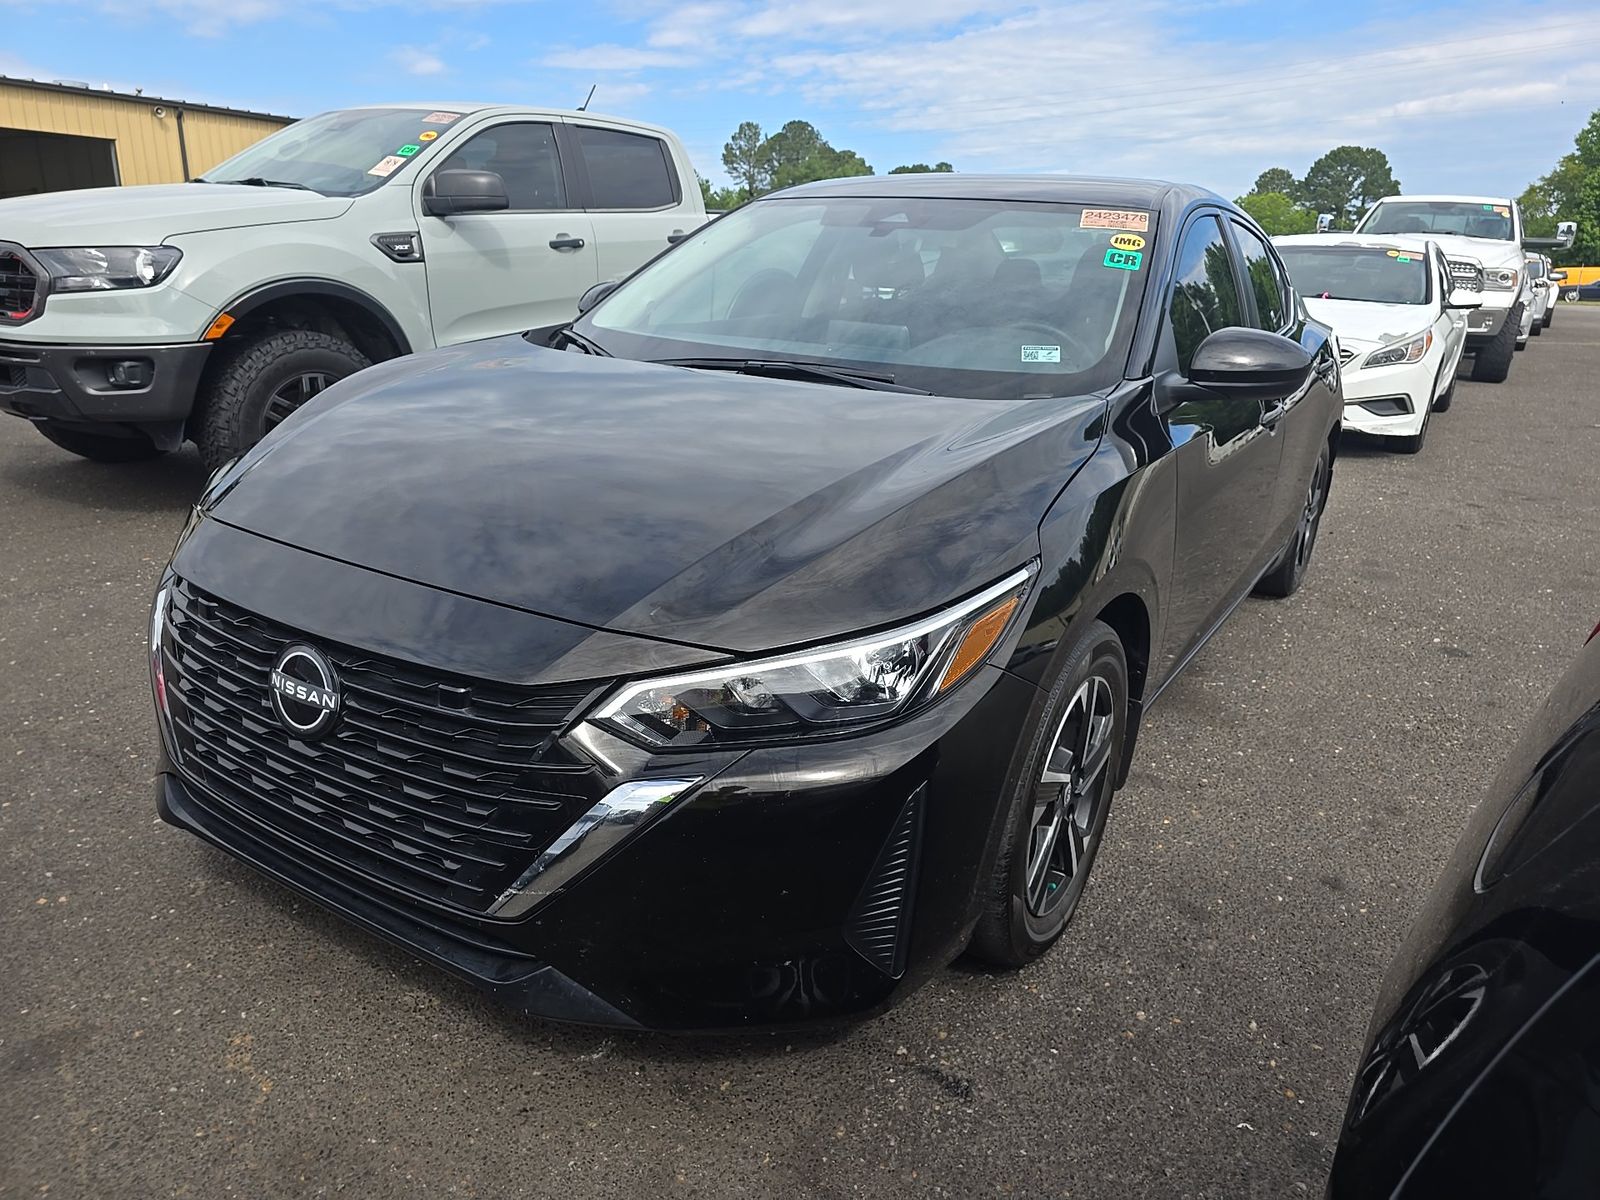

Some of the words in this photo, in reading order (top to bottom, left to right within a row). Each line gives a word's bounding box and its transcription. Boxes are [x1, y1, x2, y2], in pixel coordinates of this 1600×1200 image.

[1084, 211, 1148, 223] 2423478
[1113, 236, 1142, 247] IMG
[1109, 252, 1138, 266] CR
[271, 672, 336, 709] NISSAN
